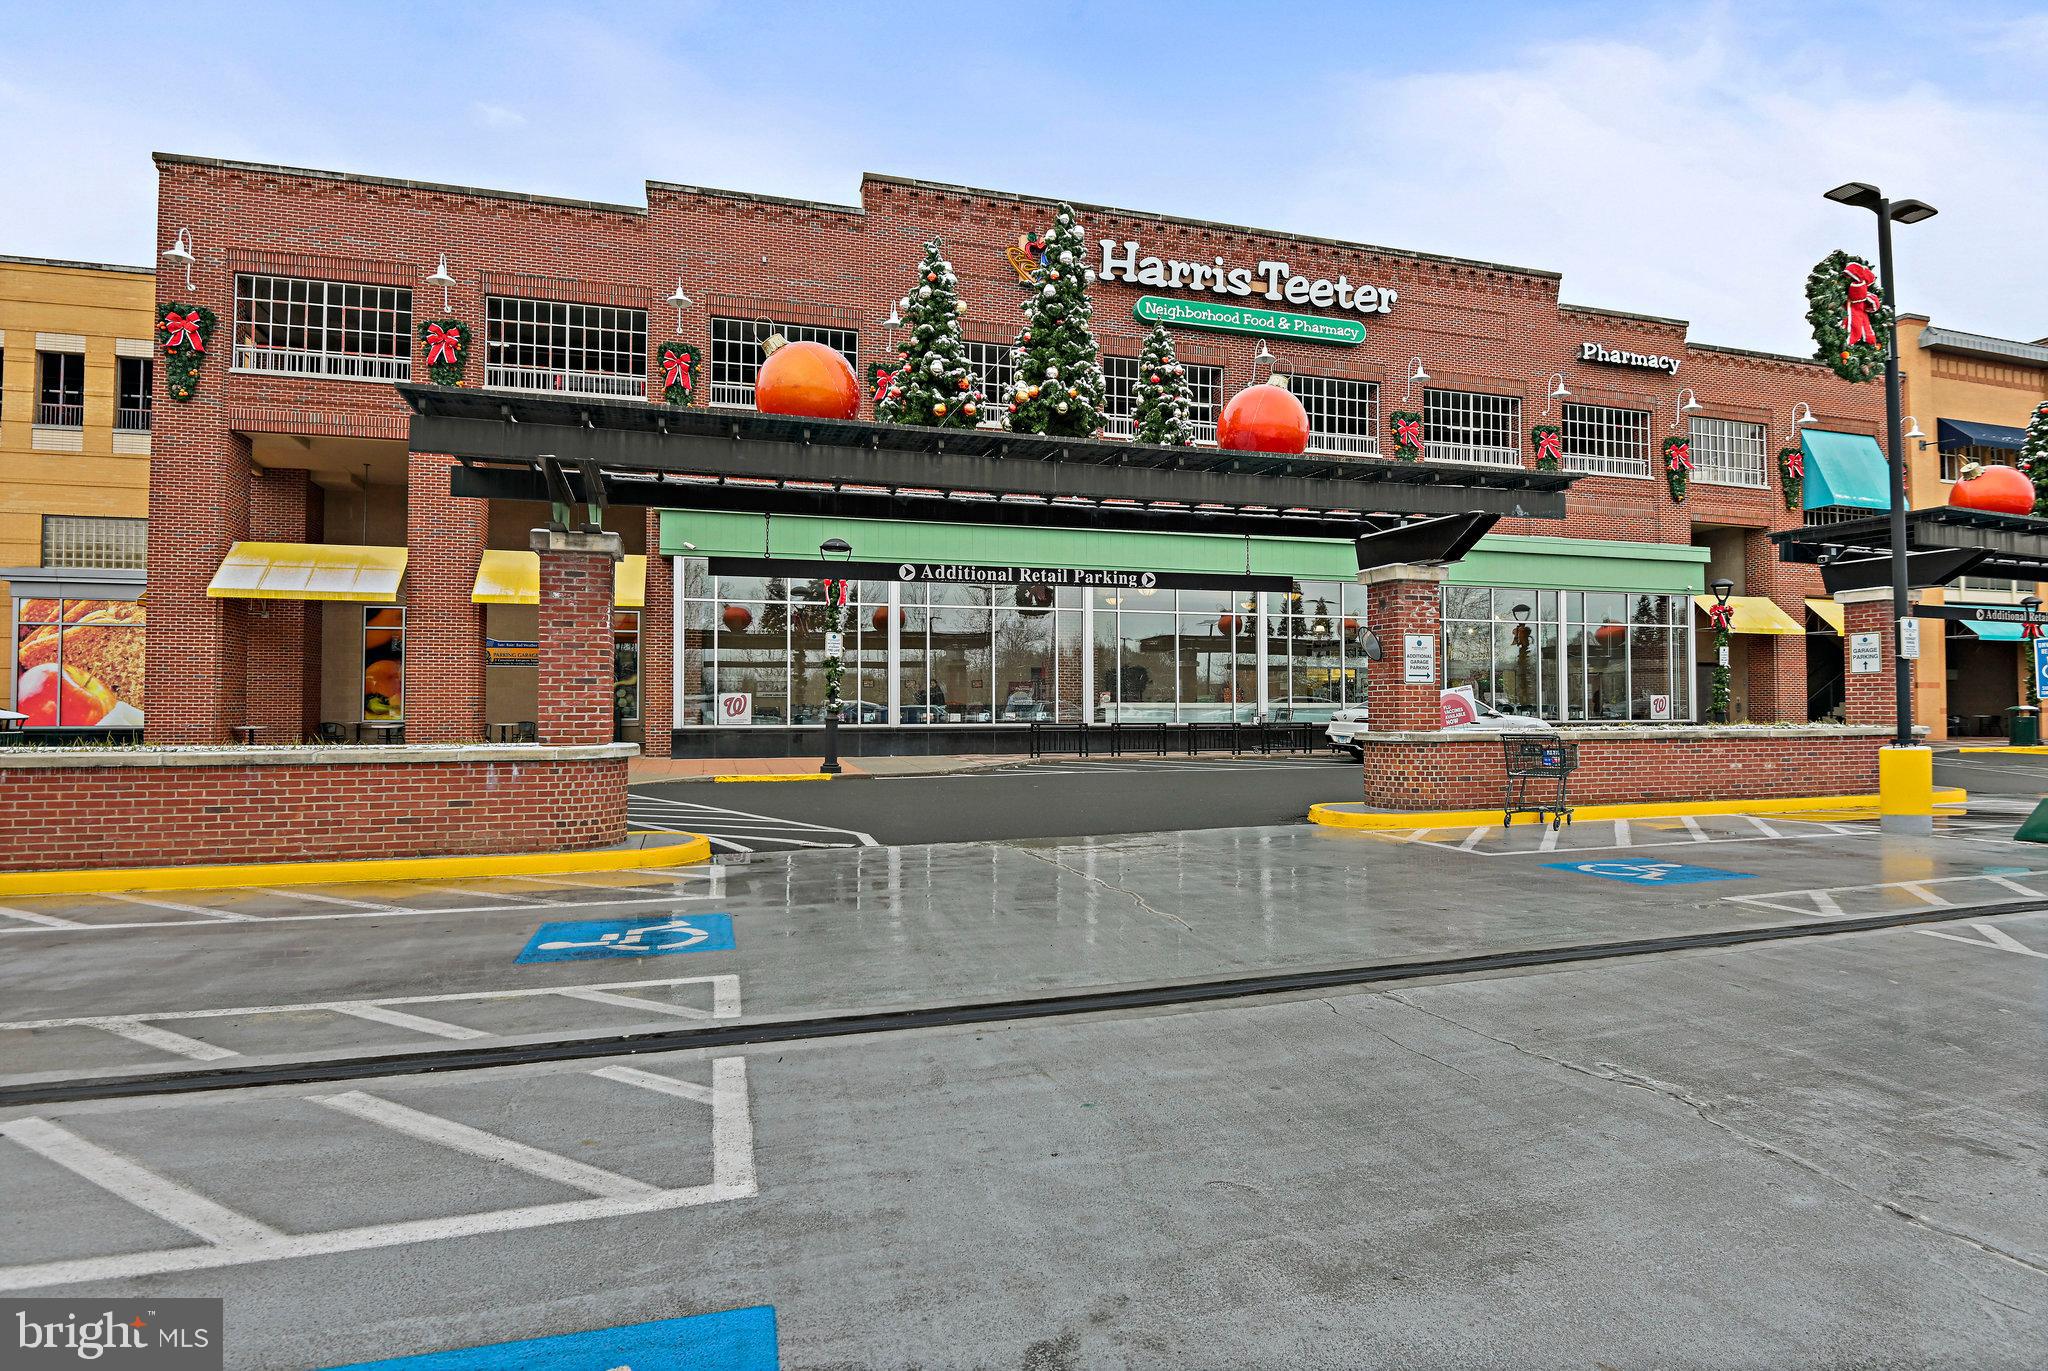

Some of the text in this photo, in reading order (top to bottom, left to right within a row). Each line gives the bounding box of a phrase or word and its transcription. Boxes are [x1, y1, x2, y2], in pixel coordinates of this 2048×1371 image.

[1099, 239, 1398, 314] Harris Teeter
[1145, 302, 1360, 341] Neighborhood Food & Pharmacy
[1582, 342, 1681, 376] Pharmacy
[921, 565, 1138, 588] Additional Retail Parking
[1985, 608, 2027, 621] Additional
[1446, 717, 1459, 726] NOW
